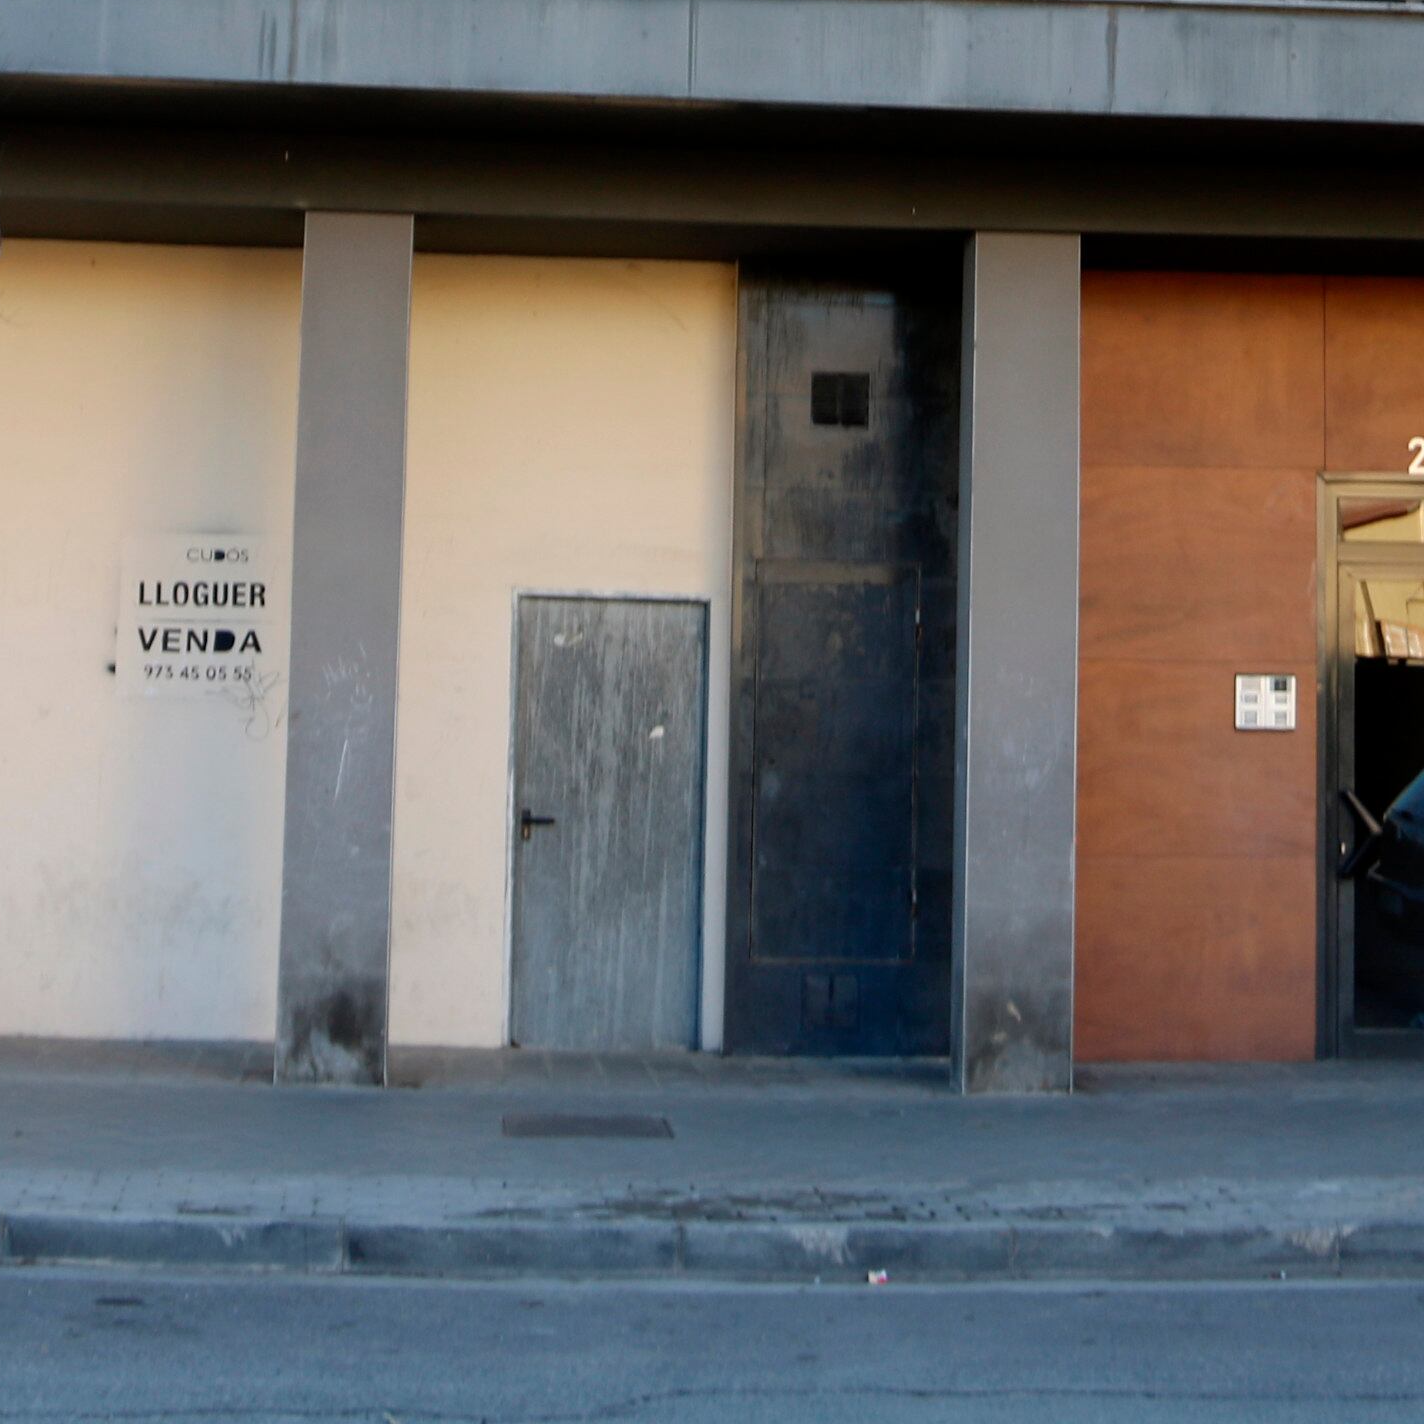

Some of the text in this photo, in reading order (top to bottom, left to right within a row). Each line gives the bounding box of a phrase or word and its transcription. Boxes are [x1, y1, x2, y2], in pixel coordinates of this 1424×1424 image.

[138, 581, 266, 608] LLOGUER
[138, 627, 262, 654] VENDA
[179, 665, 200, 681] 45
[206, 665, 227, 681] 05
[233, 665, 252, 682] 55
